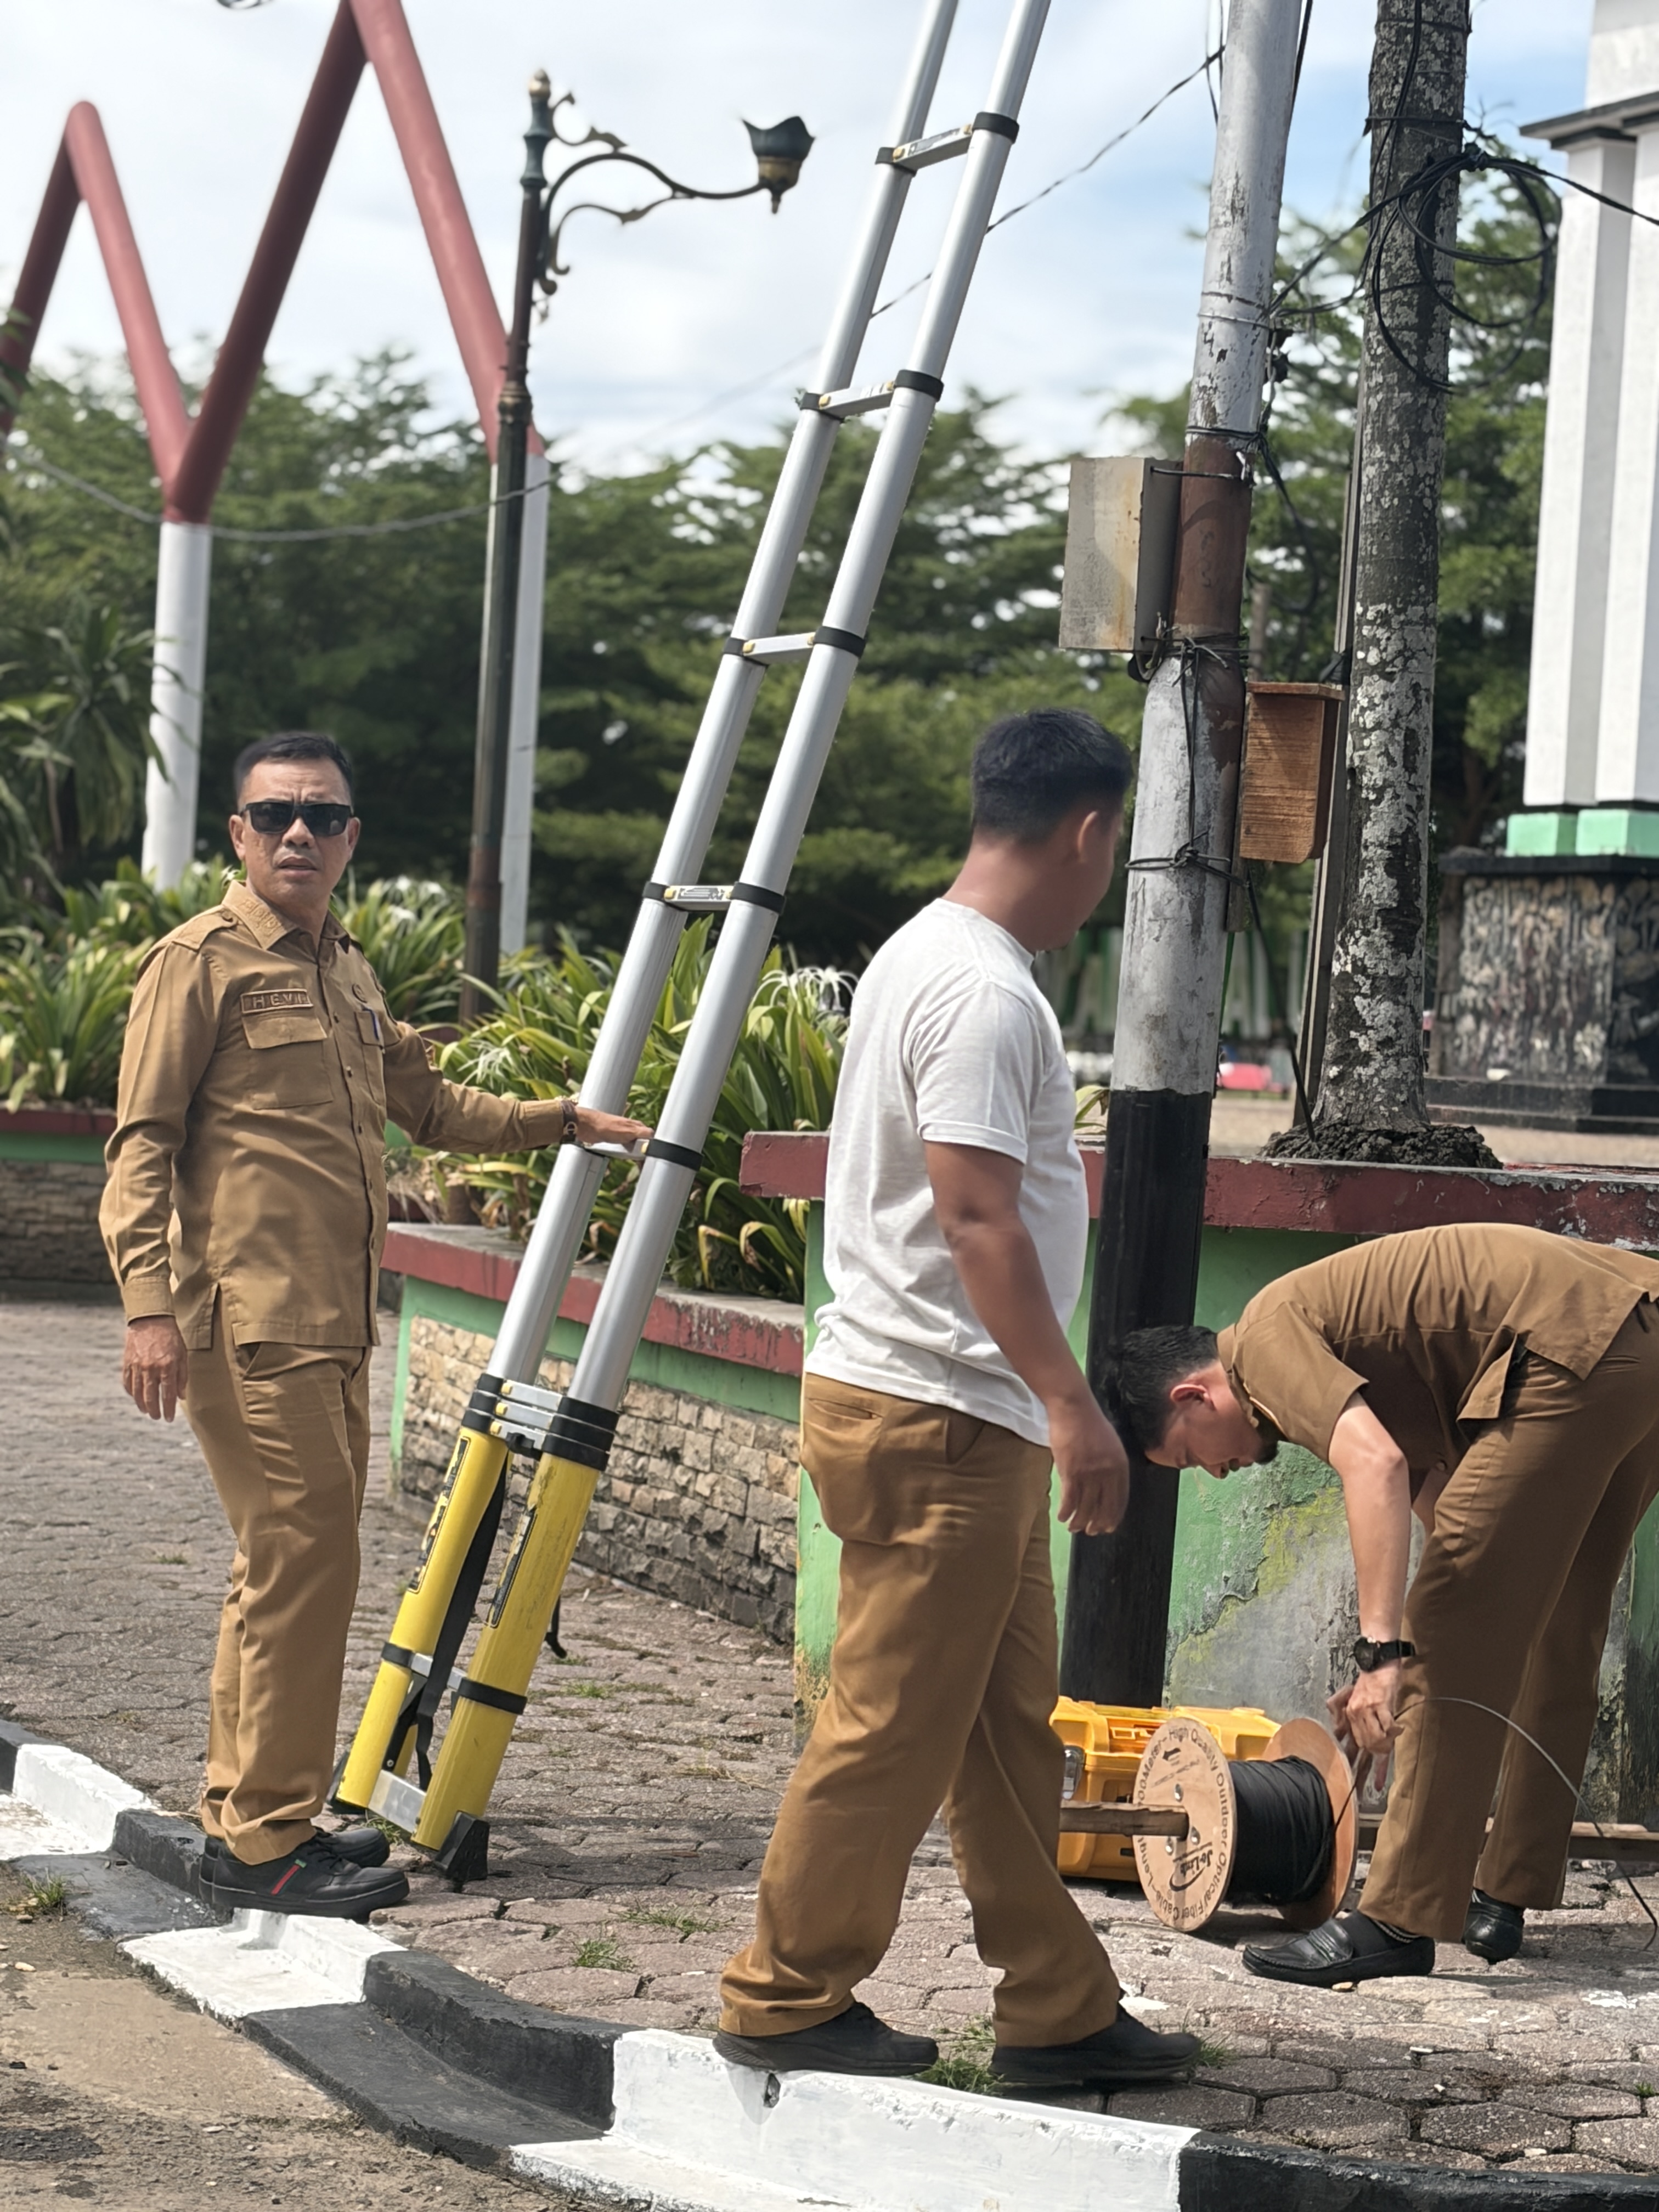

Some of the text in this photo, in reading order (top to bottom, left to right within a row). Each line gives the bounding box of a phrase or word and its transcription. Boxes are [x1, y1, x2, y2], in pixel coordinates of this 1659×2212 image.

[1191, 1728, 1218, 1771] Quality
[1216, 1772, 1229, 1848] Outdoor
[1204, 1852, 1227, 1907] Optical
[1181, 1900, 1204, 1919] Fiber
